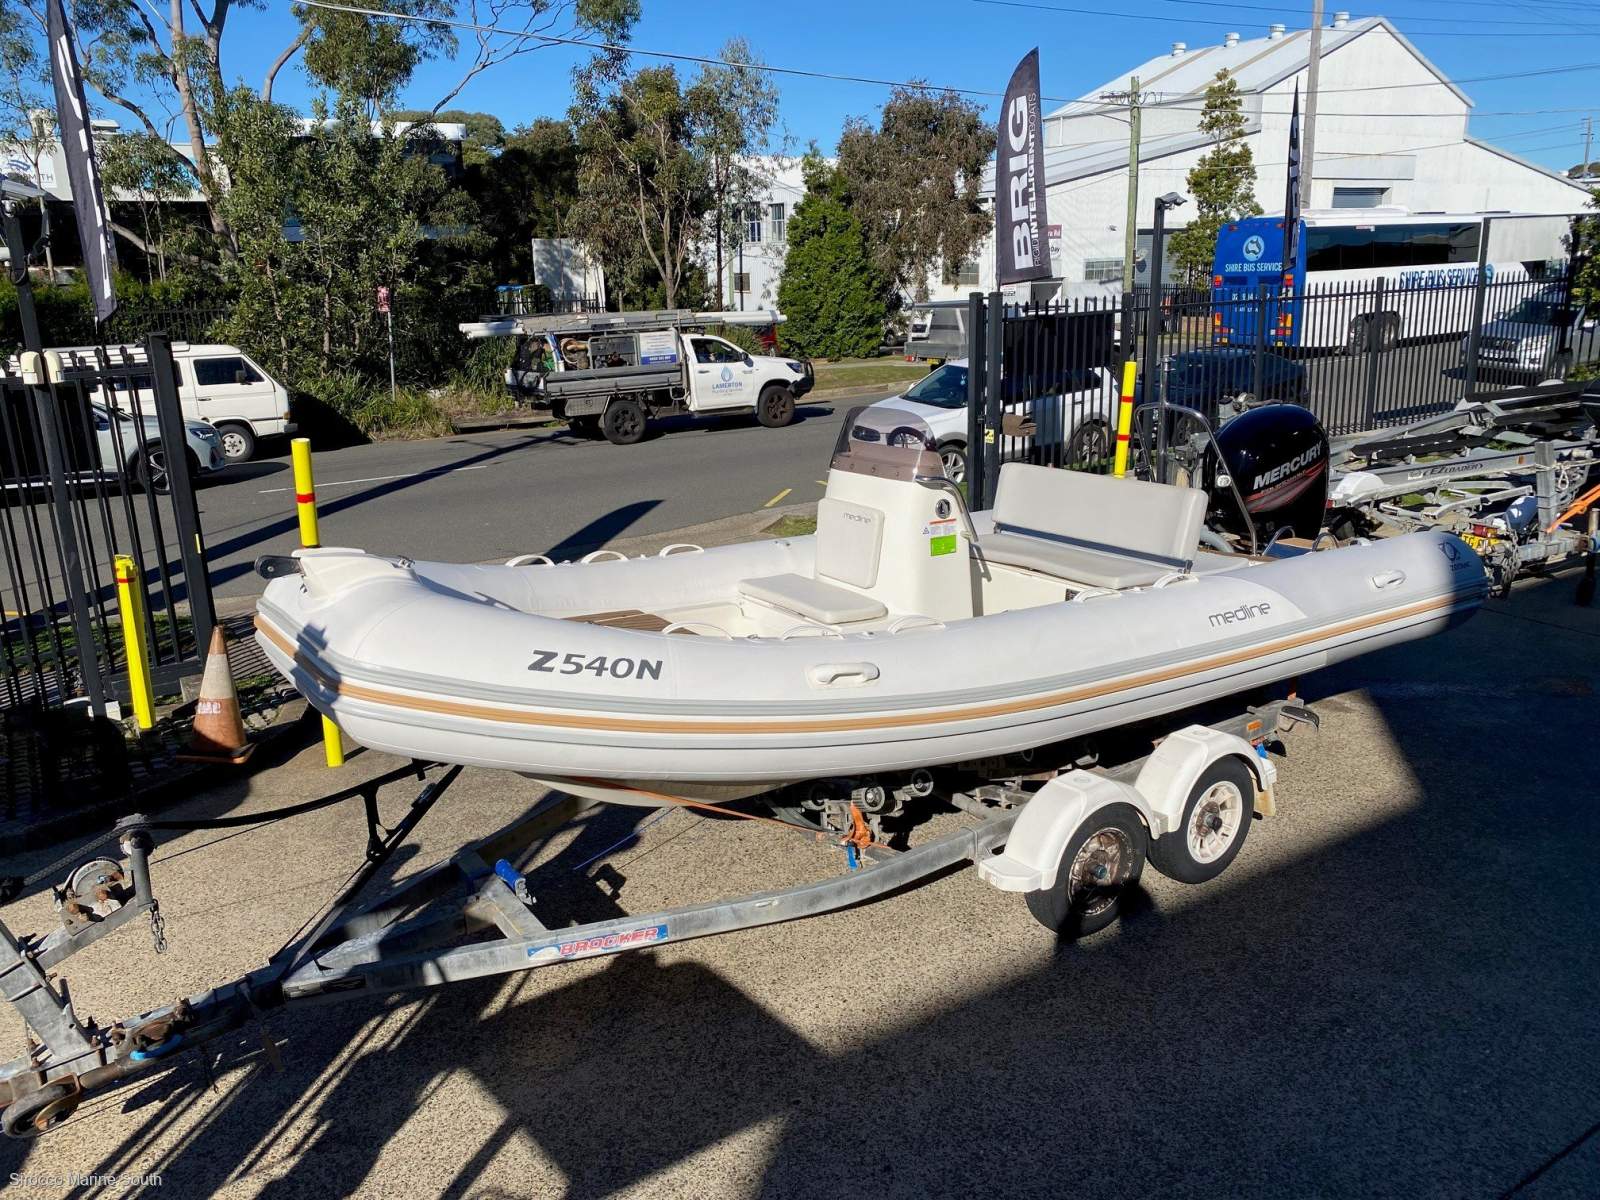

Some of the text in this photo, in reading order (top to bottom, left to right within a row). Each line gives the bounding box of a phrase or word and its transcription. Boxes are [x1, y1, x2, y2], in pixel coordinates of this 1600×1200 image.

[1008, 95, 1033, 270] BRIG
[1225, 262, 1283, 272] SHIRE BUS SERVICE
[1427, 269, 1444, 288] BUS
[1253, 440, 1322, 490] MERCURY
[1208, 603, 1271, 627] medline
[527, 649, 663, 680] Z540N
